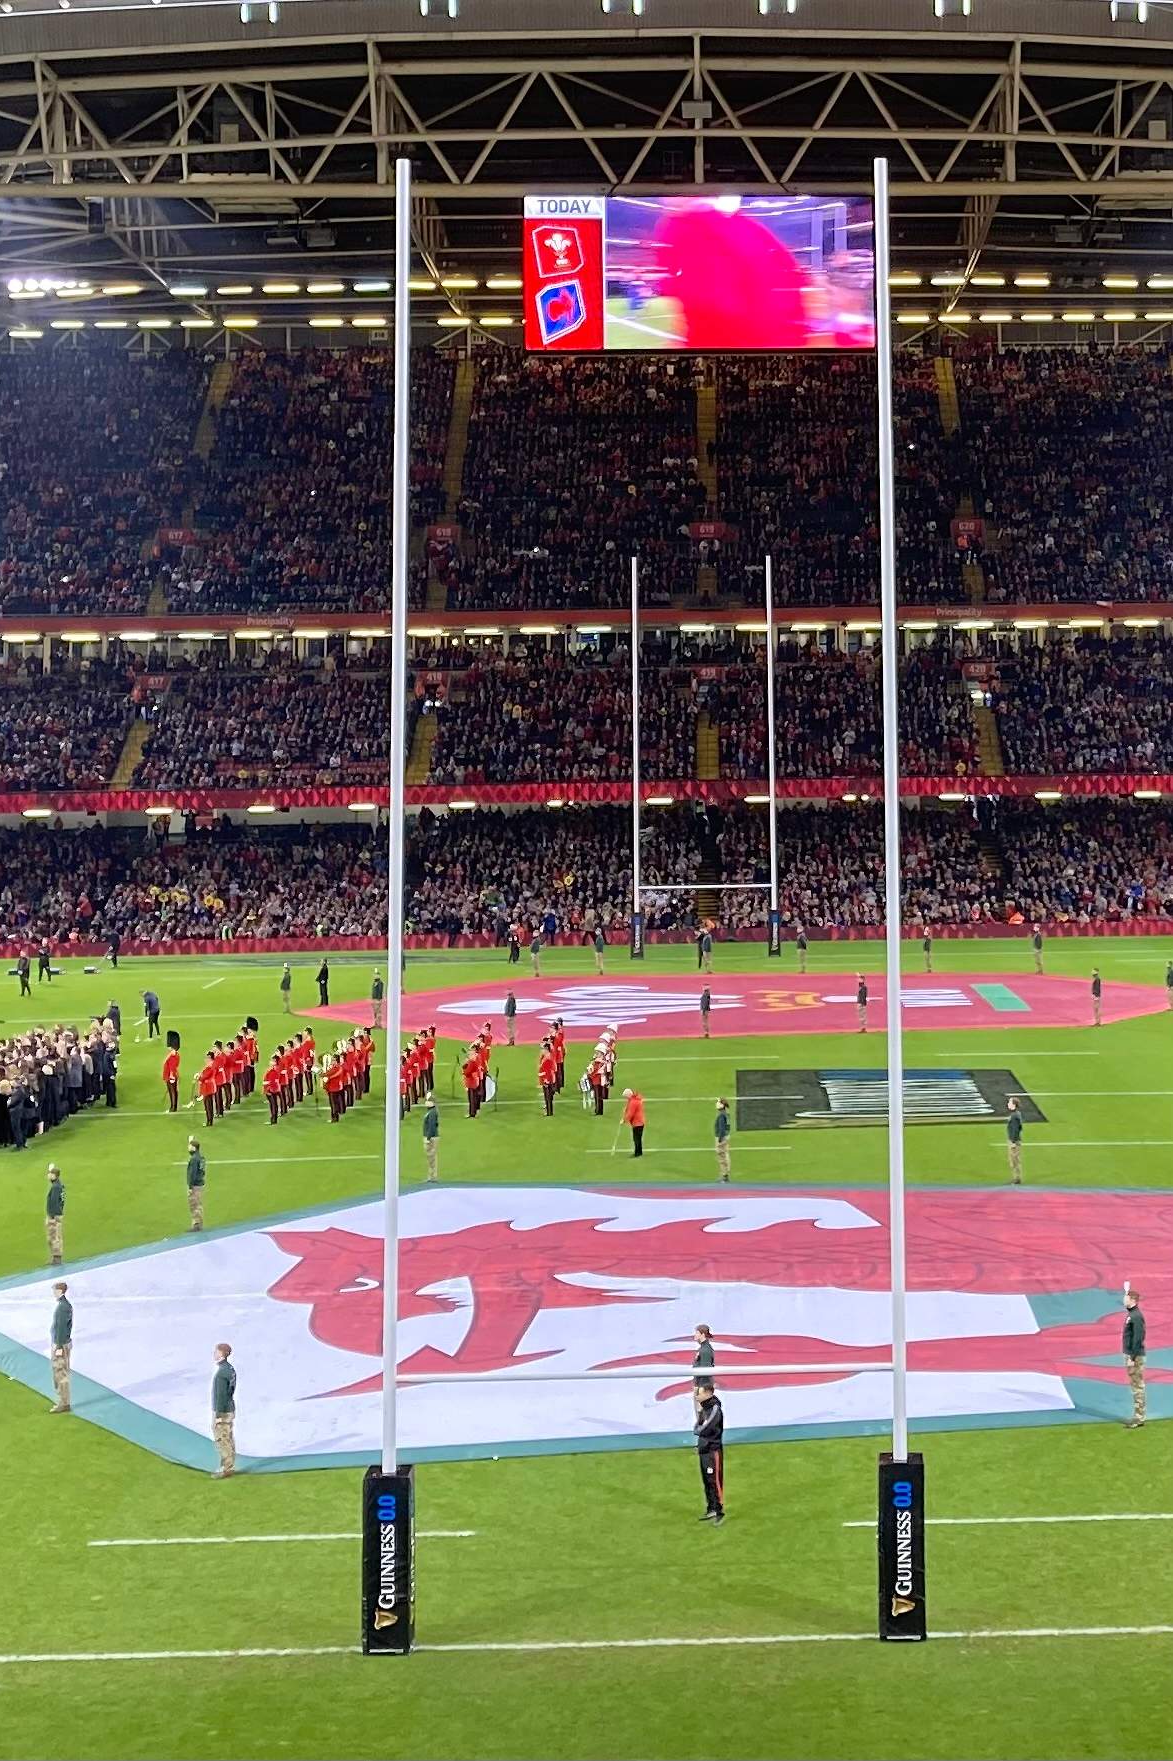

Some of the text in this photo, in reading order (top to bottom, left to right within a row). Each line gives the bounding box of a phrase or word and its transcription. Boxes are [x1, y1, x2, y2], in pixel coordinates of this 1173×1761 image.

[538, 199, 591, 213] TODAY
[936, 607, 982, 618] Principality
[247, 617, 294, 628] Principality
[893, 1481, 912, 1596] GUINNESS 0.0
[378, 1495, 396, 1610] GUINNESS 0.0
